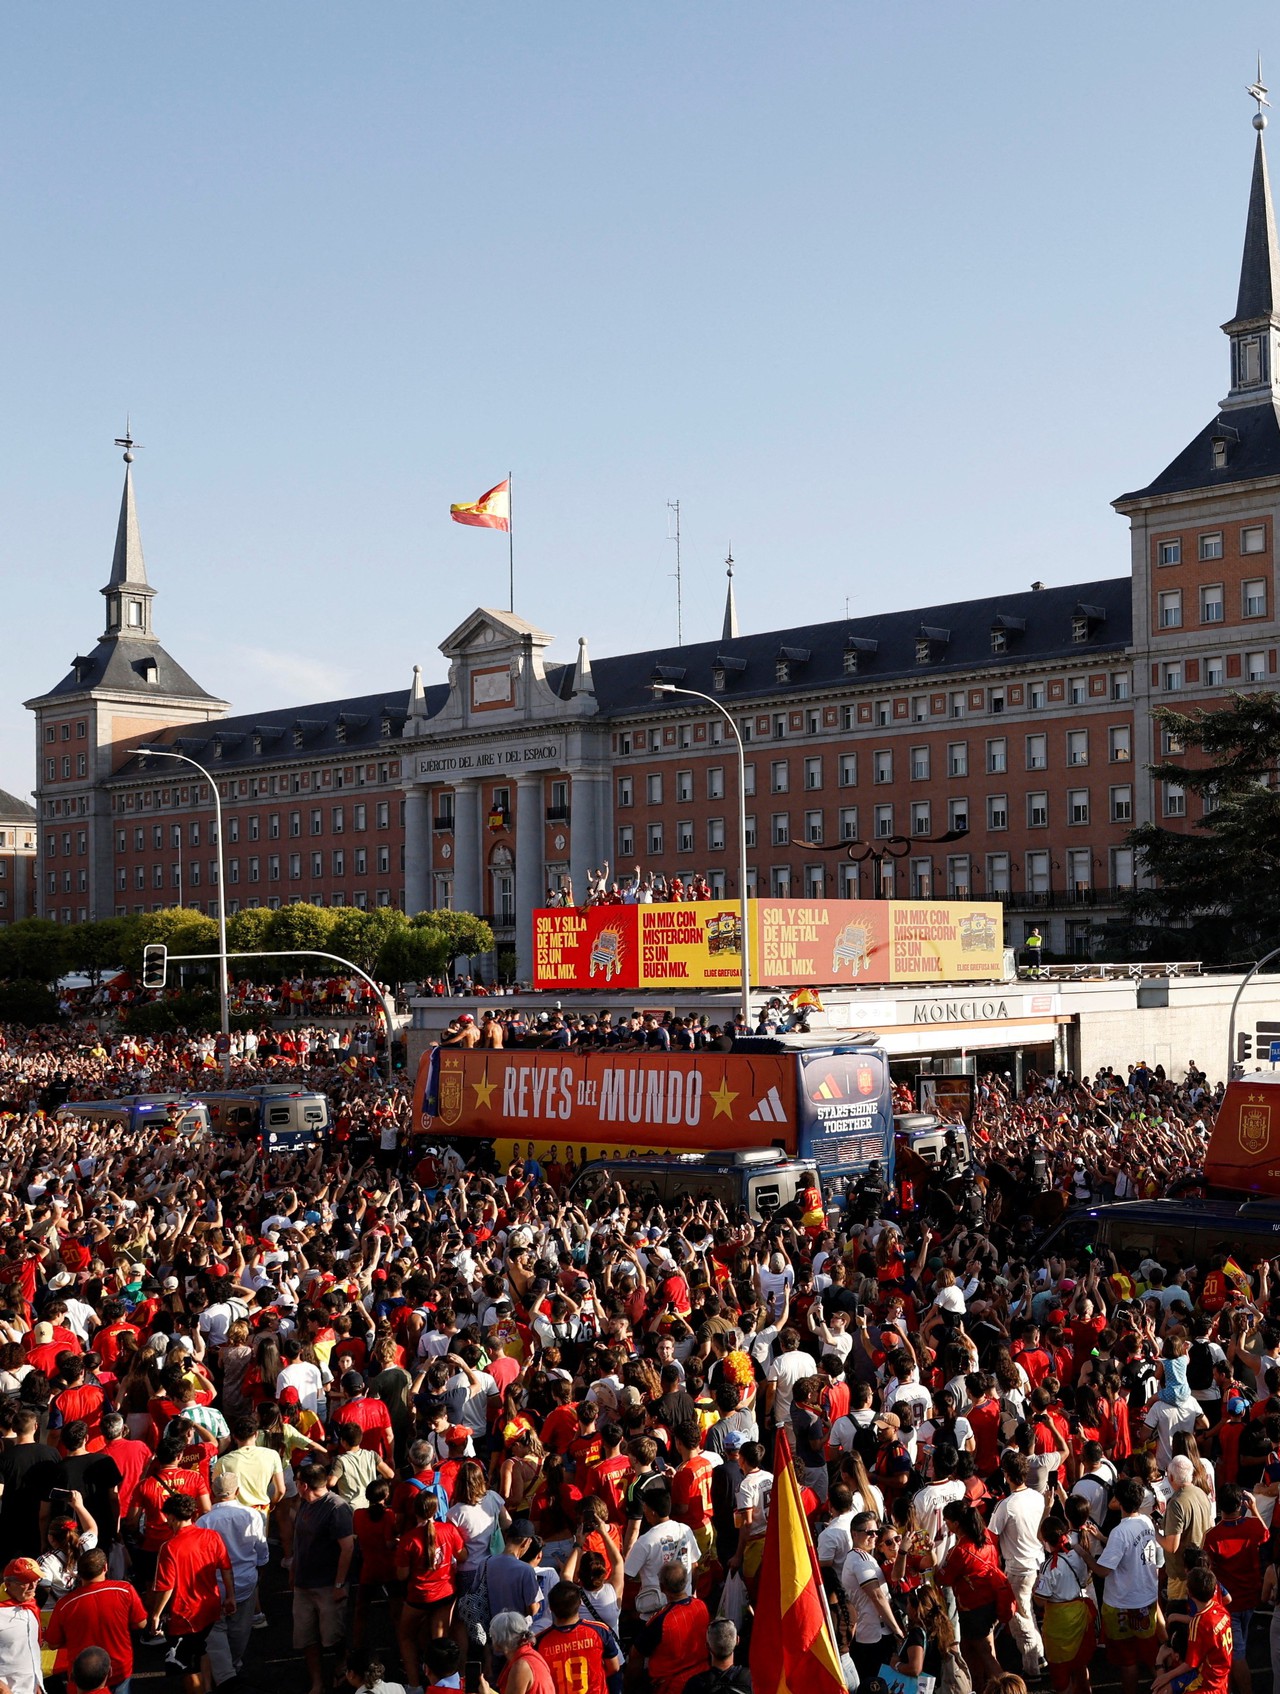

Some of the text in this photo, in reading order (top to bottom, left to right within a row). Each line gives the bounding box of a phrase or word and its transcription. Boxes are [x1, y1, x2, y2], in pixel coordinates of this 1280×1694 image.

[421, 745, 557, 773] EJÉRCITO DEL AIRE Y DEL ESPACIO
[537, 915, 587, 933] SOL Y SILLA
[643, 911, 696, 929] UN MIX CON
[763, 908, 829, 925] SOL Y SILLA
[894, 910, 950, 925] UN MIX CON
[537, 932, 579, 949] DE METAL
[643, 927, 703, 946] MISTERCORN
[763, 925, 818, 942] DE METAL
[894, 926, 957, 941] MISTERCORN
[537, 949, 562, 964] ES UN
[643, 946, 668, 962] ES UN
[764, 942, 796, 959] ES UN
[894, 942, 921, 957] ES UN
[537, 964, 577, 980] MAL MIX.
[643, 962, 689, 978] BUEN MIX.
[704, 969, 717, 977] ELIGE
[718, 969, 739, 977] GREFUSA
[764, 959, 791, 976] MAL
[791, 958, 816, 975] MIX.
[894, 957, 943, 972] BUEN MIX.
[956, 964, 969, 972] ELIGE
[970, 963, 990, 972] GREFUSA
[913, 1000, 1009, 1023] MONCLOA
[502, 1066, 703, 1126] REYES DEL MUNDO
[817, 1102, 878, 1120] STARS SHINE
[823, 1117, 873, 1134] TOGETHER
[62, 1248, 82, 1264] 20
[1203, 1279, 1218, 1296] 20
[578, 1321, 593, 1341] 26
[613, 1478, 628, 1503] 7
[544, 1638, 594, 1657] ZUBIMENDI
[1222, 1626, 1233, 1656] 19
